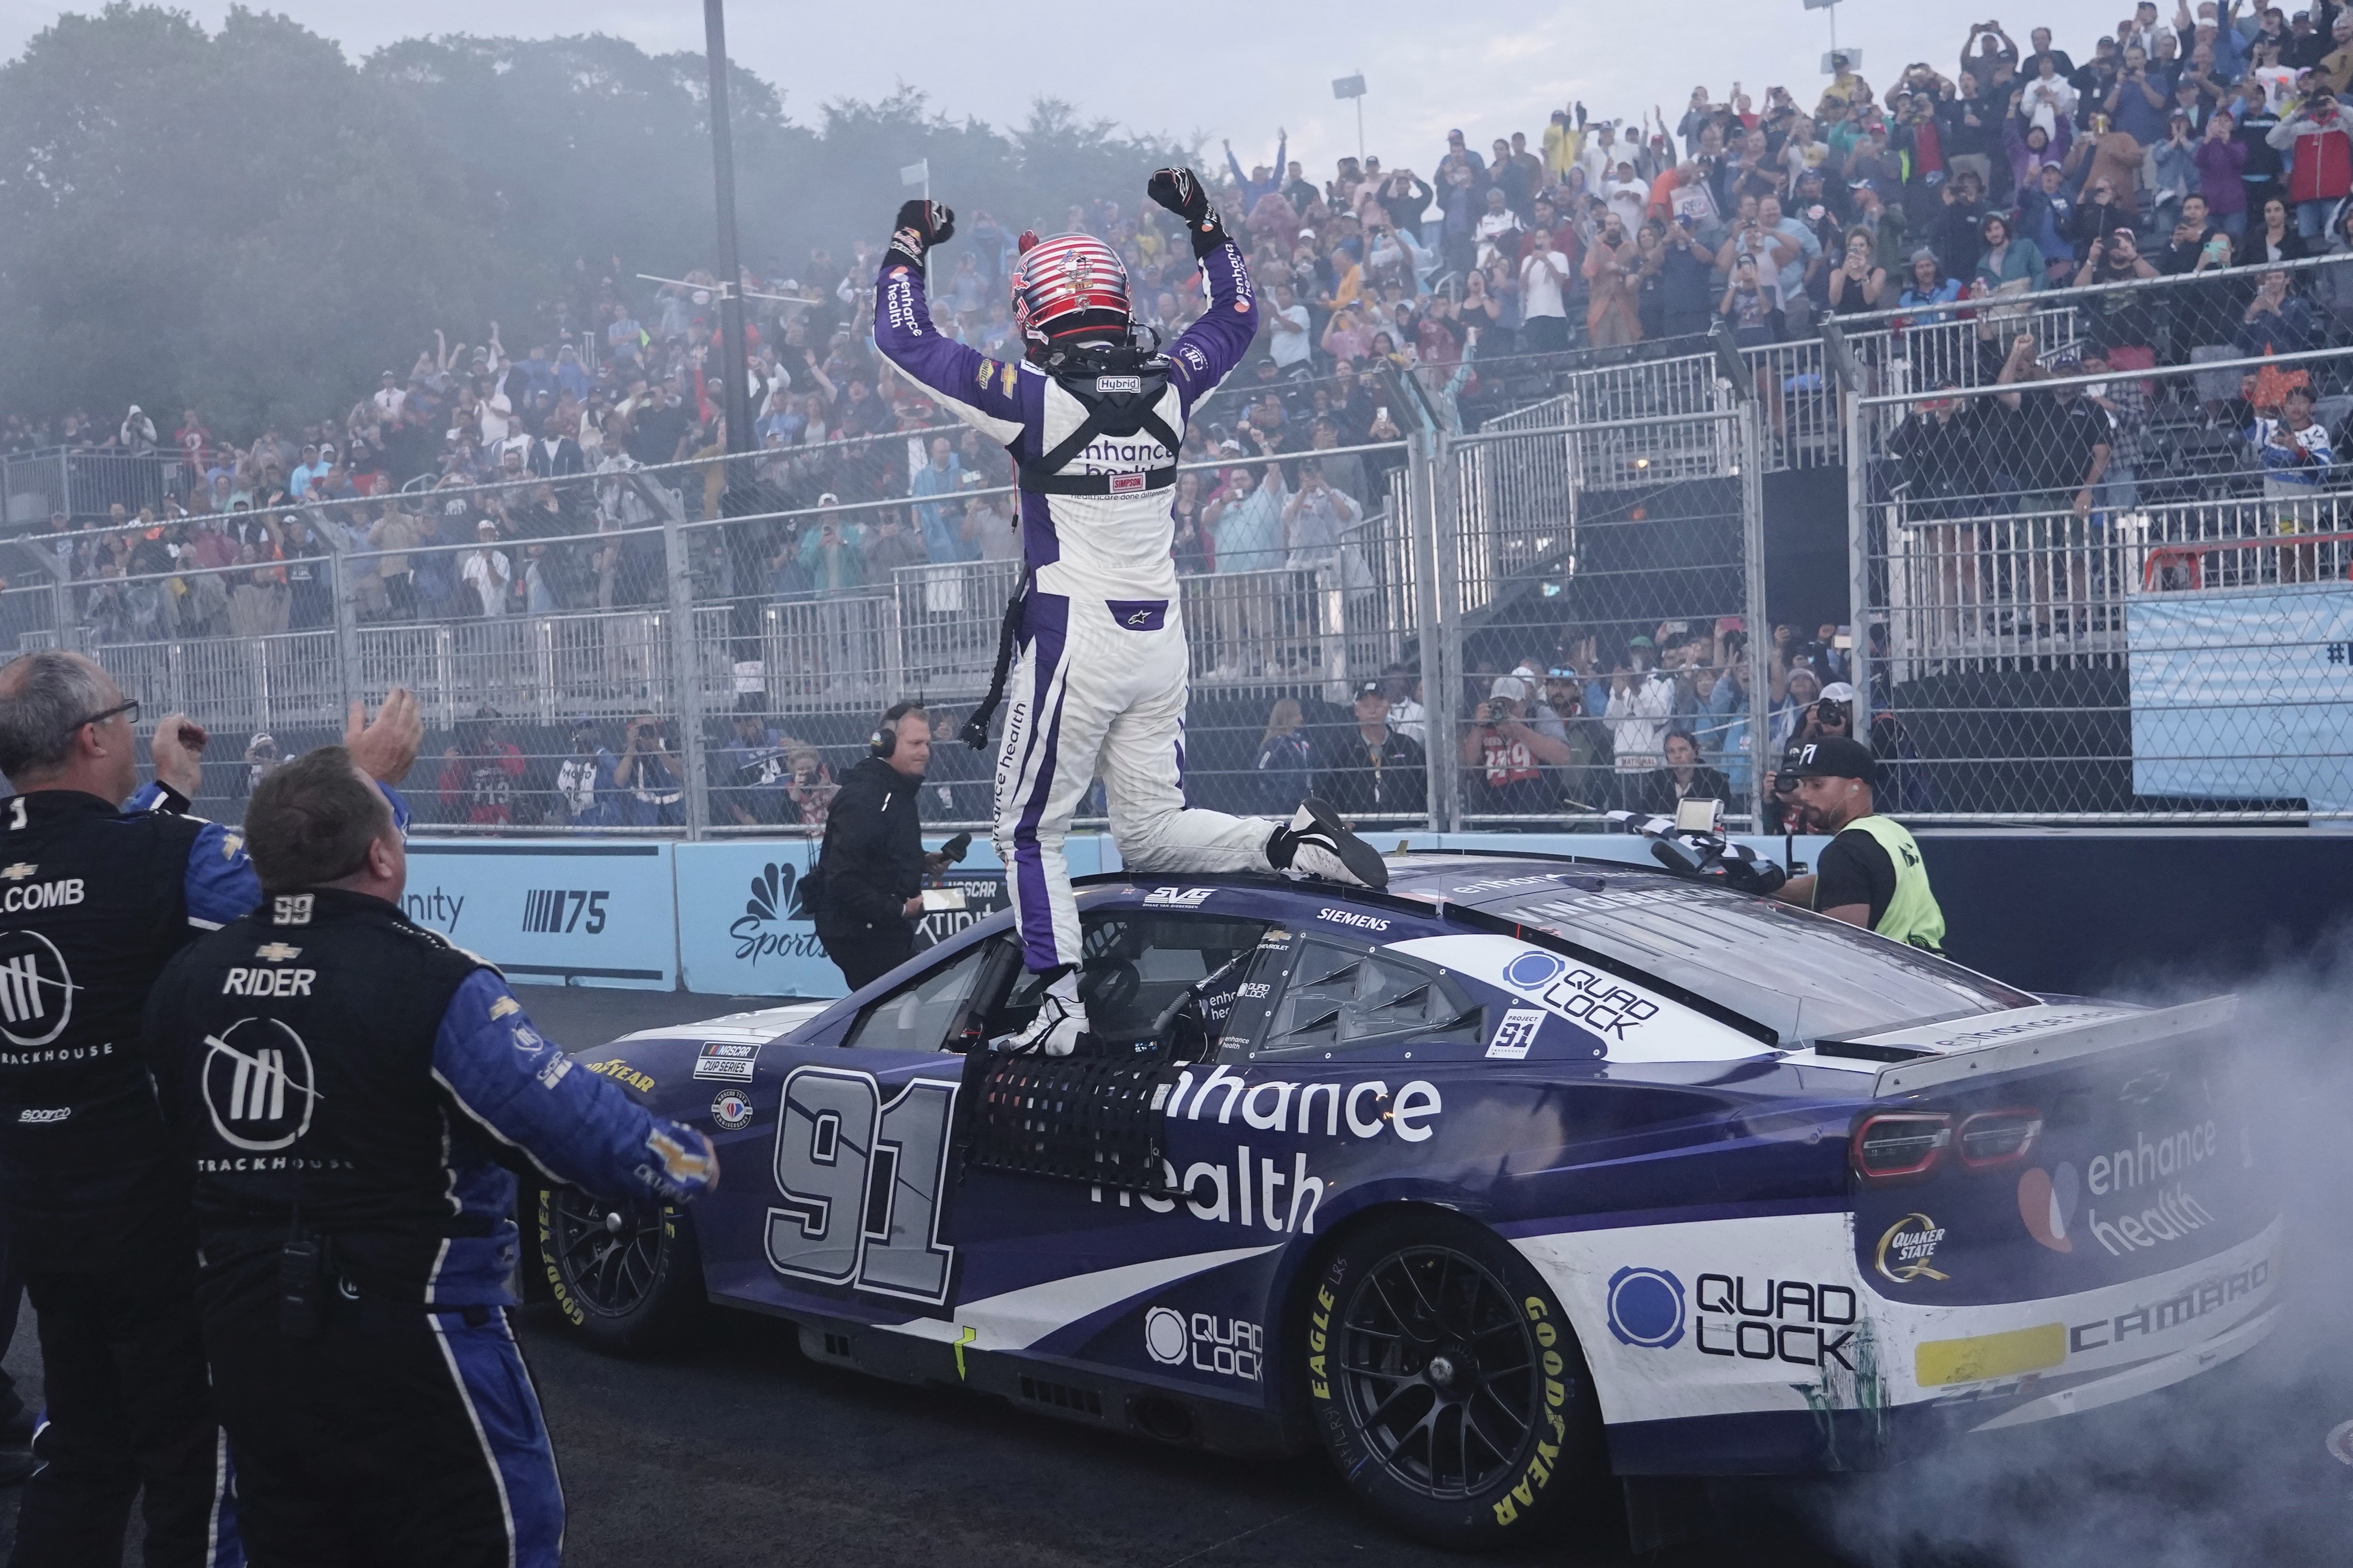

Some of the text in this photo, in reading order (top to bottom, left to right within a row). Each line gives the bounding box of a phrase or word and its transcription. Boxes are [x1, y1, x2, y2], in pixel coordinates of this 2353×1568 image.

[1225, 243, 1245, 295] enhance
[888, 283, 903, 328] health
[900, 282, 923, 337] enhance
[979, 358, 991, 390] SUNOCO
[1101, 378, 1136, 391] Hybrid
[1114, 478, 1141, 488] SIMPSON
[1000, 702, 1026, 768] health
[0, 879, 85, 913] COMB
[273, 894, 315, 925] 99
[1144, 887, 1218, 904] SVG
[1499, 899, 1590, 923] VAN
[1317, 907, 1391, 932] SIEMENS
[223, 968, 317, 996] RIDER
[1245, 990, 1268, 999] LOCK
[1248, 983, 1270, 991] QUAD
[1563, 969, 1659, 1020] QUAD
[1543, 983, 1640, 1041] LOCK
[718, 1045, 752, 1057] NASCAR
[1225, 1036, 1250, 1044] enhance
[1495, 1023, 1534, 1048] 91
[703, 1060, 746, 1073] CUP SERIES
[717, 1091, 747, 1104] NASCAR 75TH
[18, 1107, 71, 1122] sparco
[716, 1114, 748, 1128] ANNIVERSARY
[2088, 1120, 2216, 1195] enhance
[764, 1064, 962, 1305] 91
[2088, 1181, 2216, 1257] health
[1892, 1228, 1945, 1249] QUAKER
[1898, 1241, 1935, 1260] STATE
[1696, 1273, 1856, 1325] QUAD
[2071, 1256, 2269, 1353] CAMARO
[1192, 1313, 1263, 1354] QUAD
[1310, 1284, 1335, 1400] EAGLE
[1696, 1316, 1856, 1371] LOCK
[1192, 1341, 1263, 1383] LOCK
[1493, 1296, 1567, 1526] GOODYEAR
